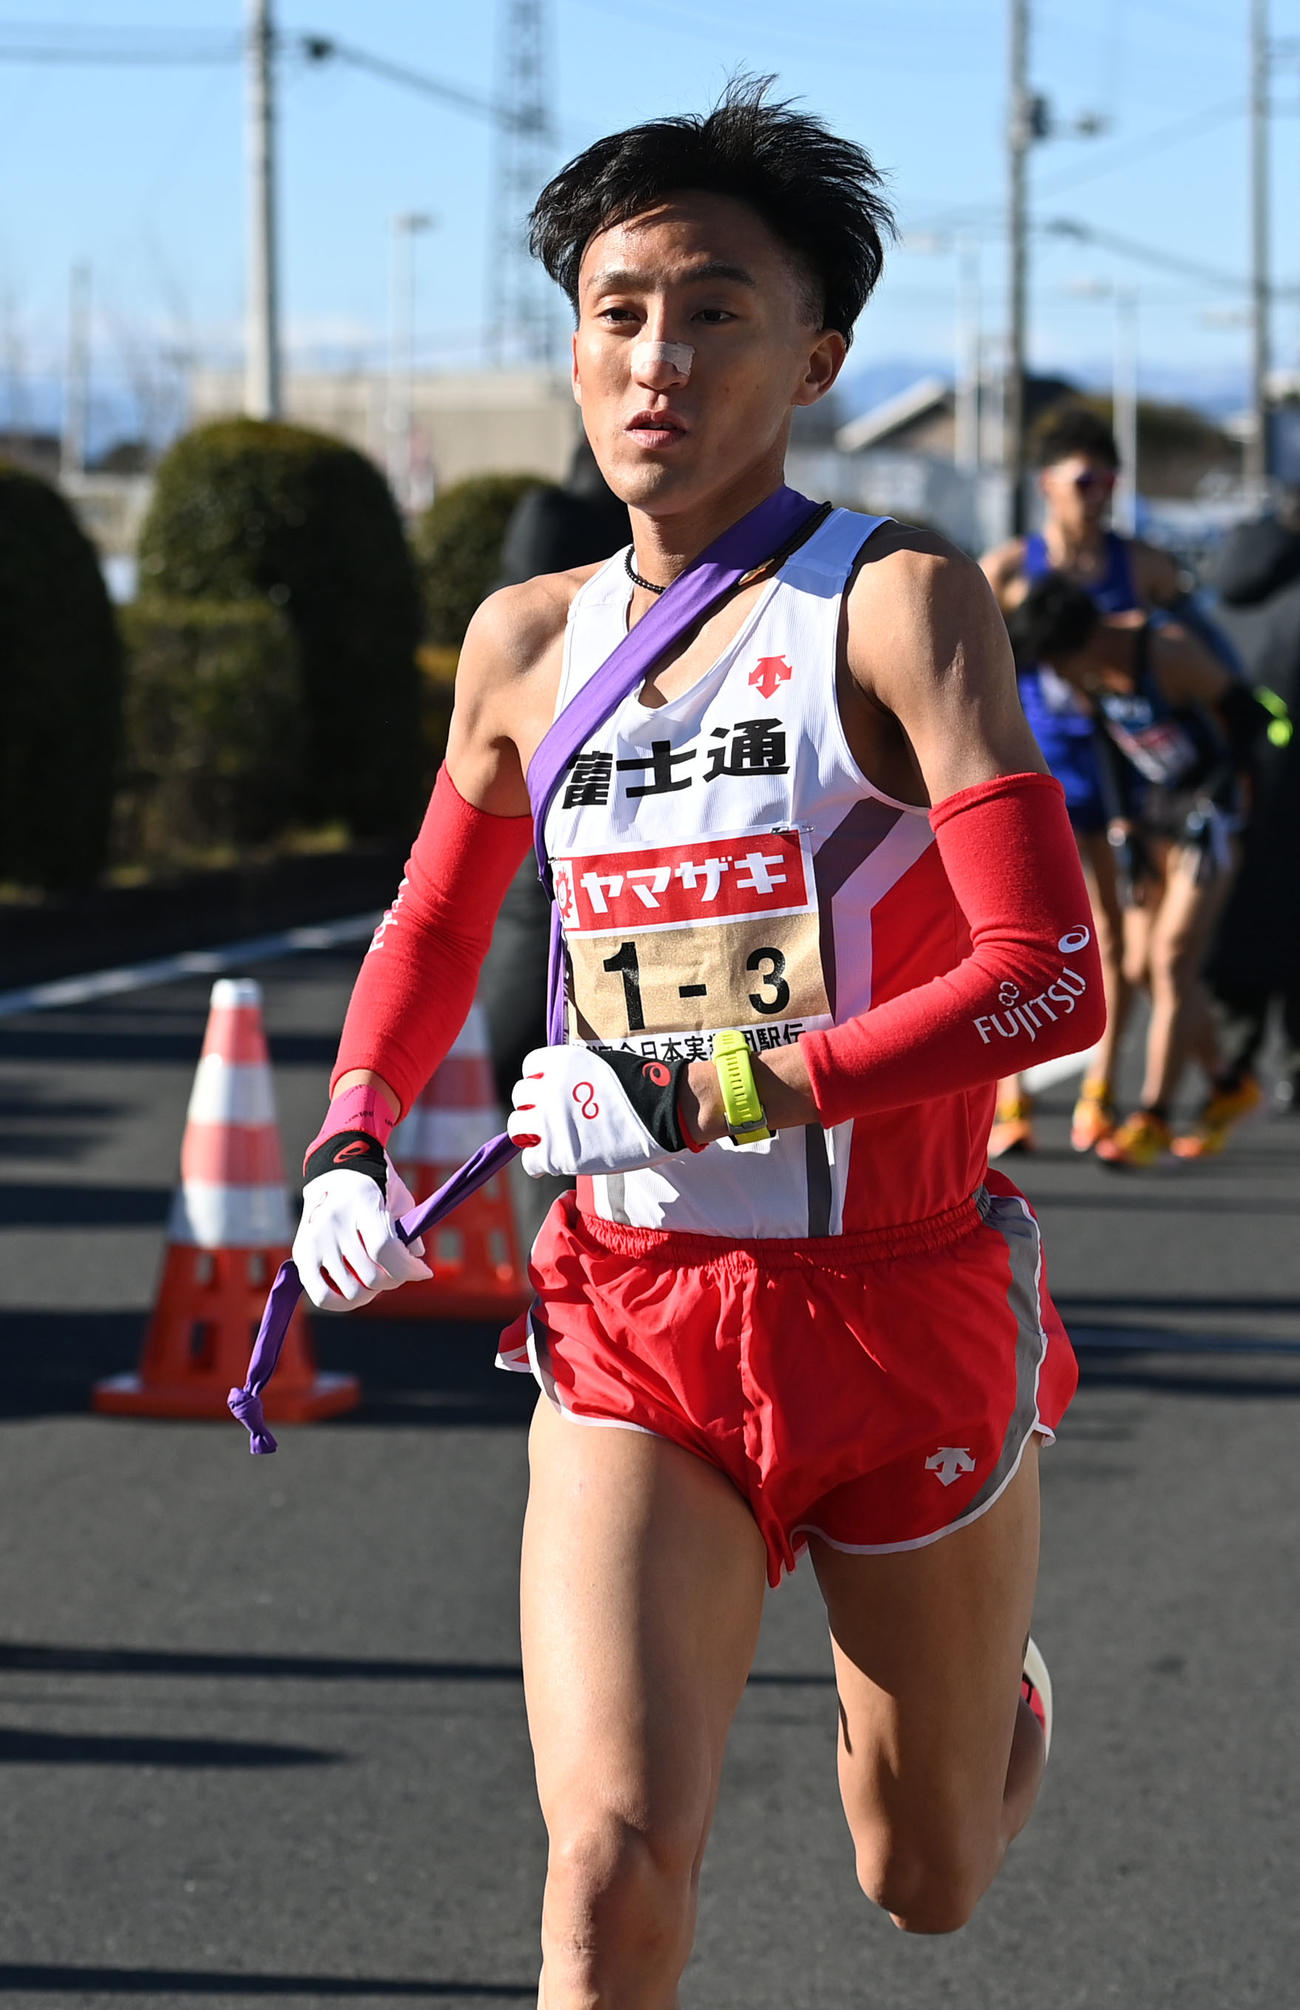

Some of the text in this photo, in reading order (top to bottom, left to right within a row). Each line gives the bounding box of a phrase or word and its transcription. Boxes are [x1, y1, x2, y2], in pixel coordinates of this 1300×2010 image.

[562, 718, 790, 809] 富士通
[580, 852, 787, 914] ヤマザキ
[973, 967, 1086, 1044] FUJITSU
